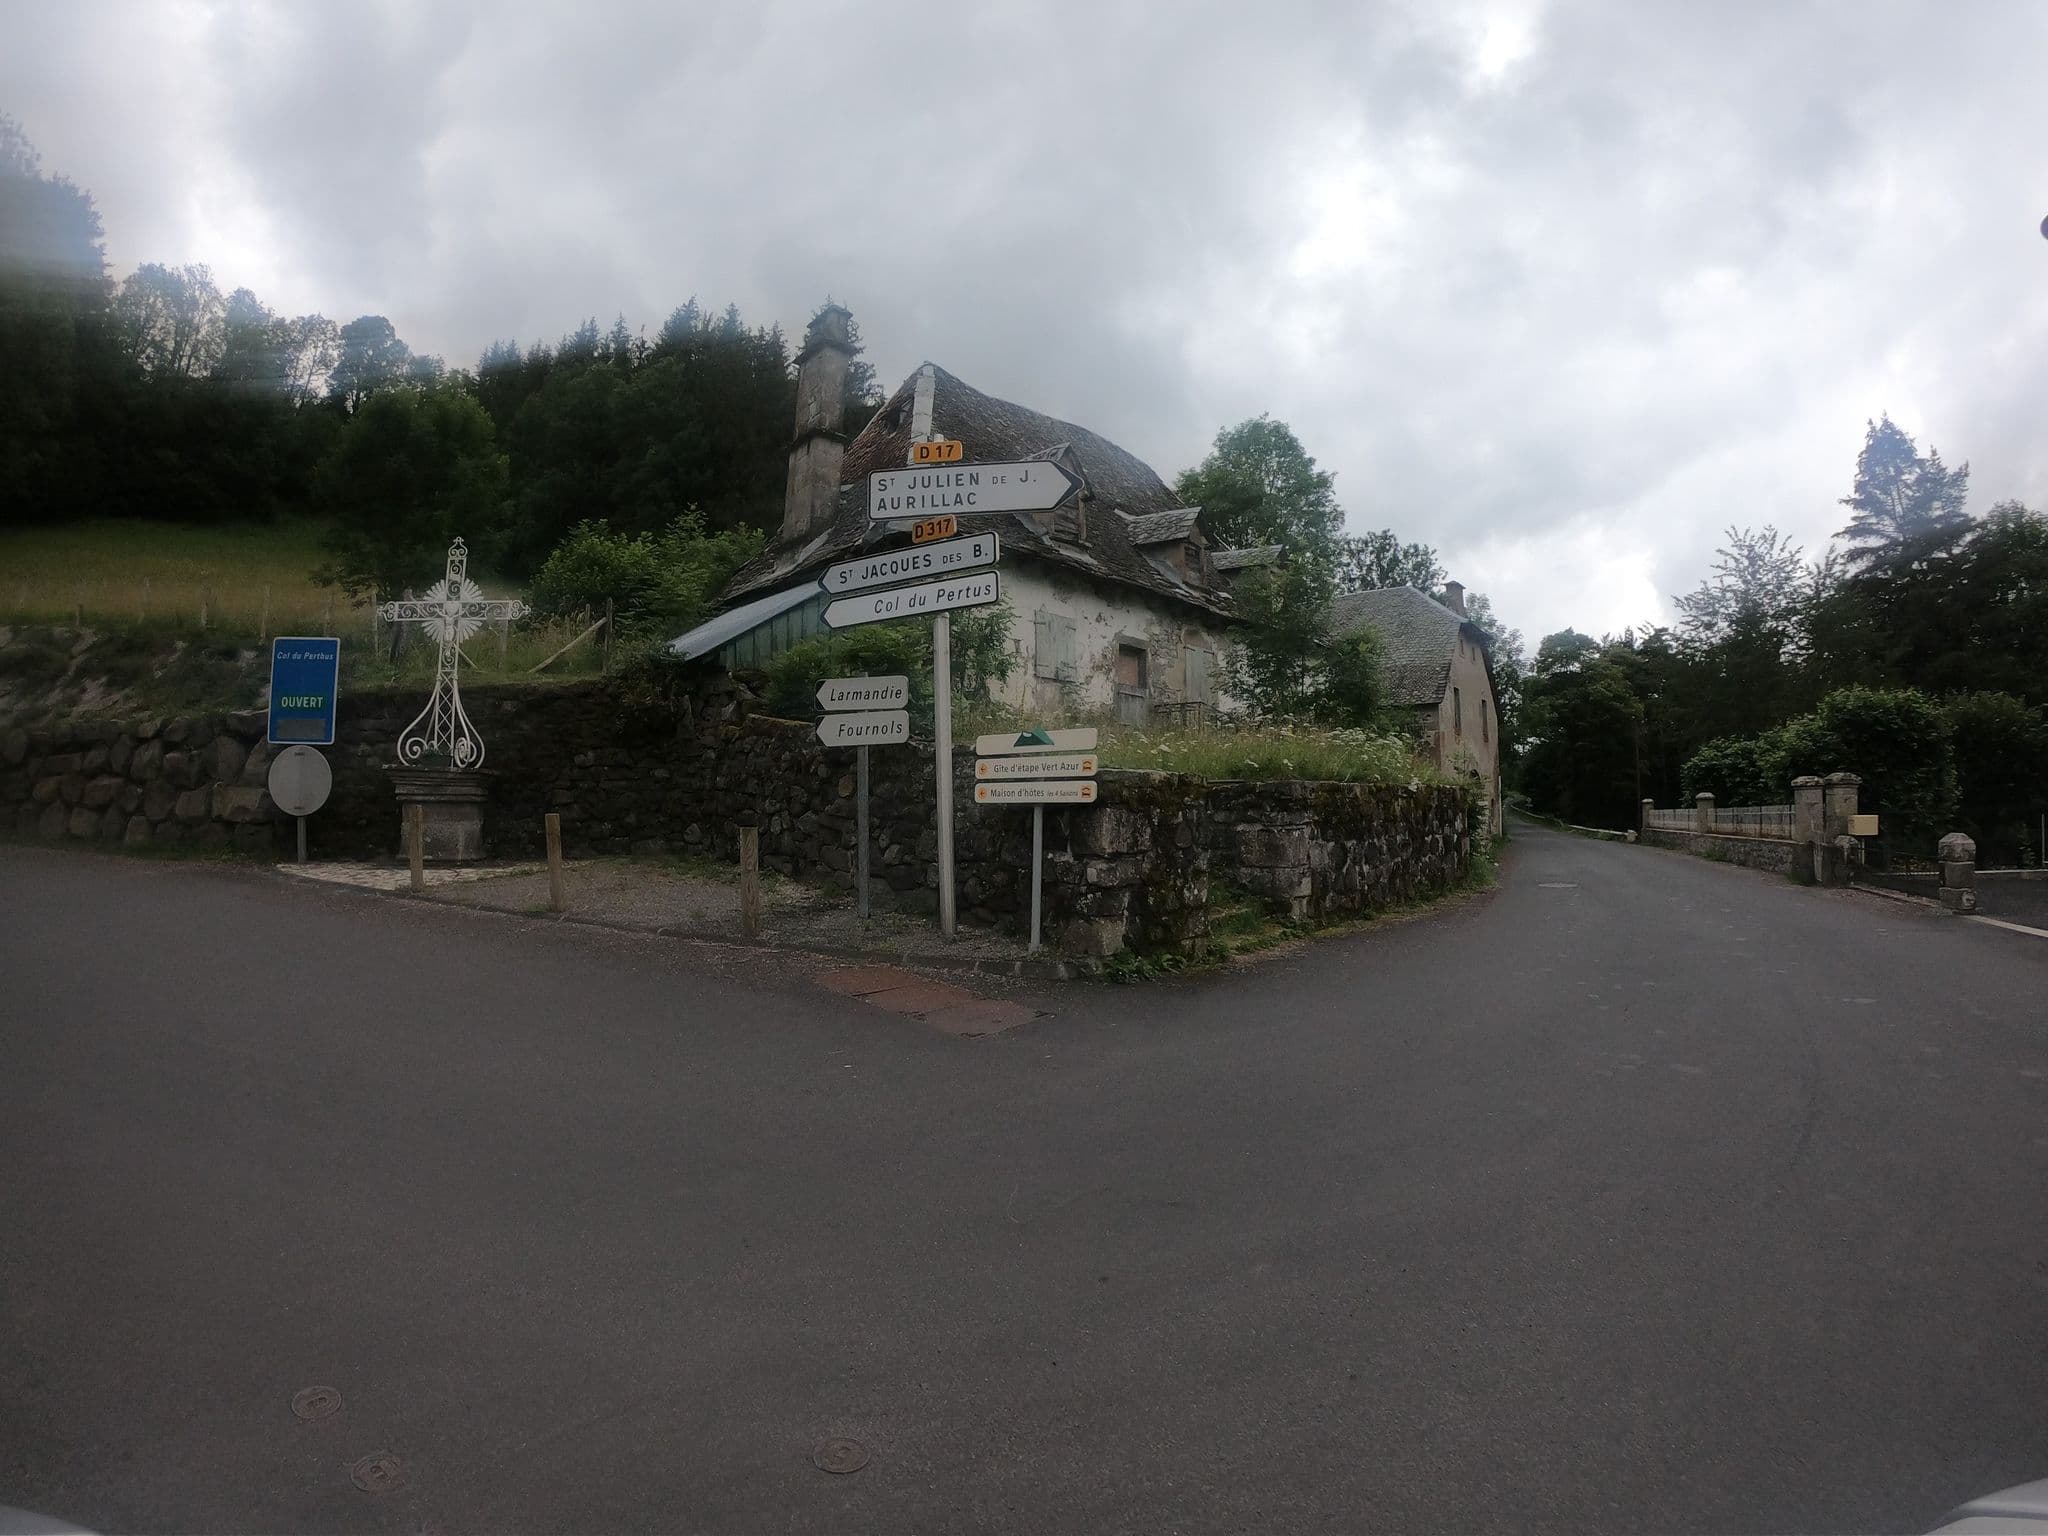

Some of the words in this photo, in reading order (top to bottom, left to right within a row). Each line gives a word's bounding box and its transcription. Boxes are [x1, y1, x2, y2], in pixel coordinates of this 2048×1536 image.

[908, 472, 980, 490] JULIEN
[992, 475, 1007, 485] DE
[1019, 469, 1038, 483] J.
[877, 492, 977, 512] AURILLAC
[861, 553, 932, 580] JACQUES
[942, 552, 962, 565] DES
[973, 543, 989, 559] B.
[874, 596, 900, 614] Col
[908, 593, 927, 608] du
[936, 583, 992, 604] Pertus
[276, 651, 290, 660] Col
[292, 651, 302, 660] du
[281, 696, 324, 708] OUVERT
[830, 685, 903, 702] Larmandie
[838, 720, 903, 738] Fournols
[1041, 762, 1058, 772] Vert
[1060, 761, 1080, 771] Azur
[990, 788, 1016, 797] Maison
